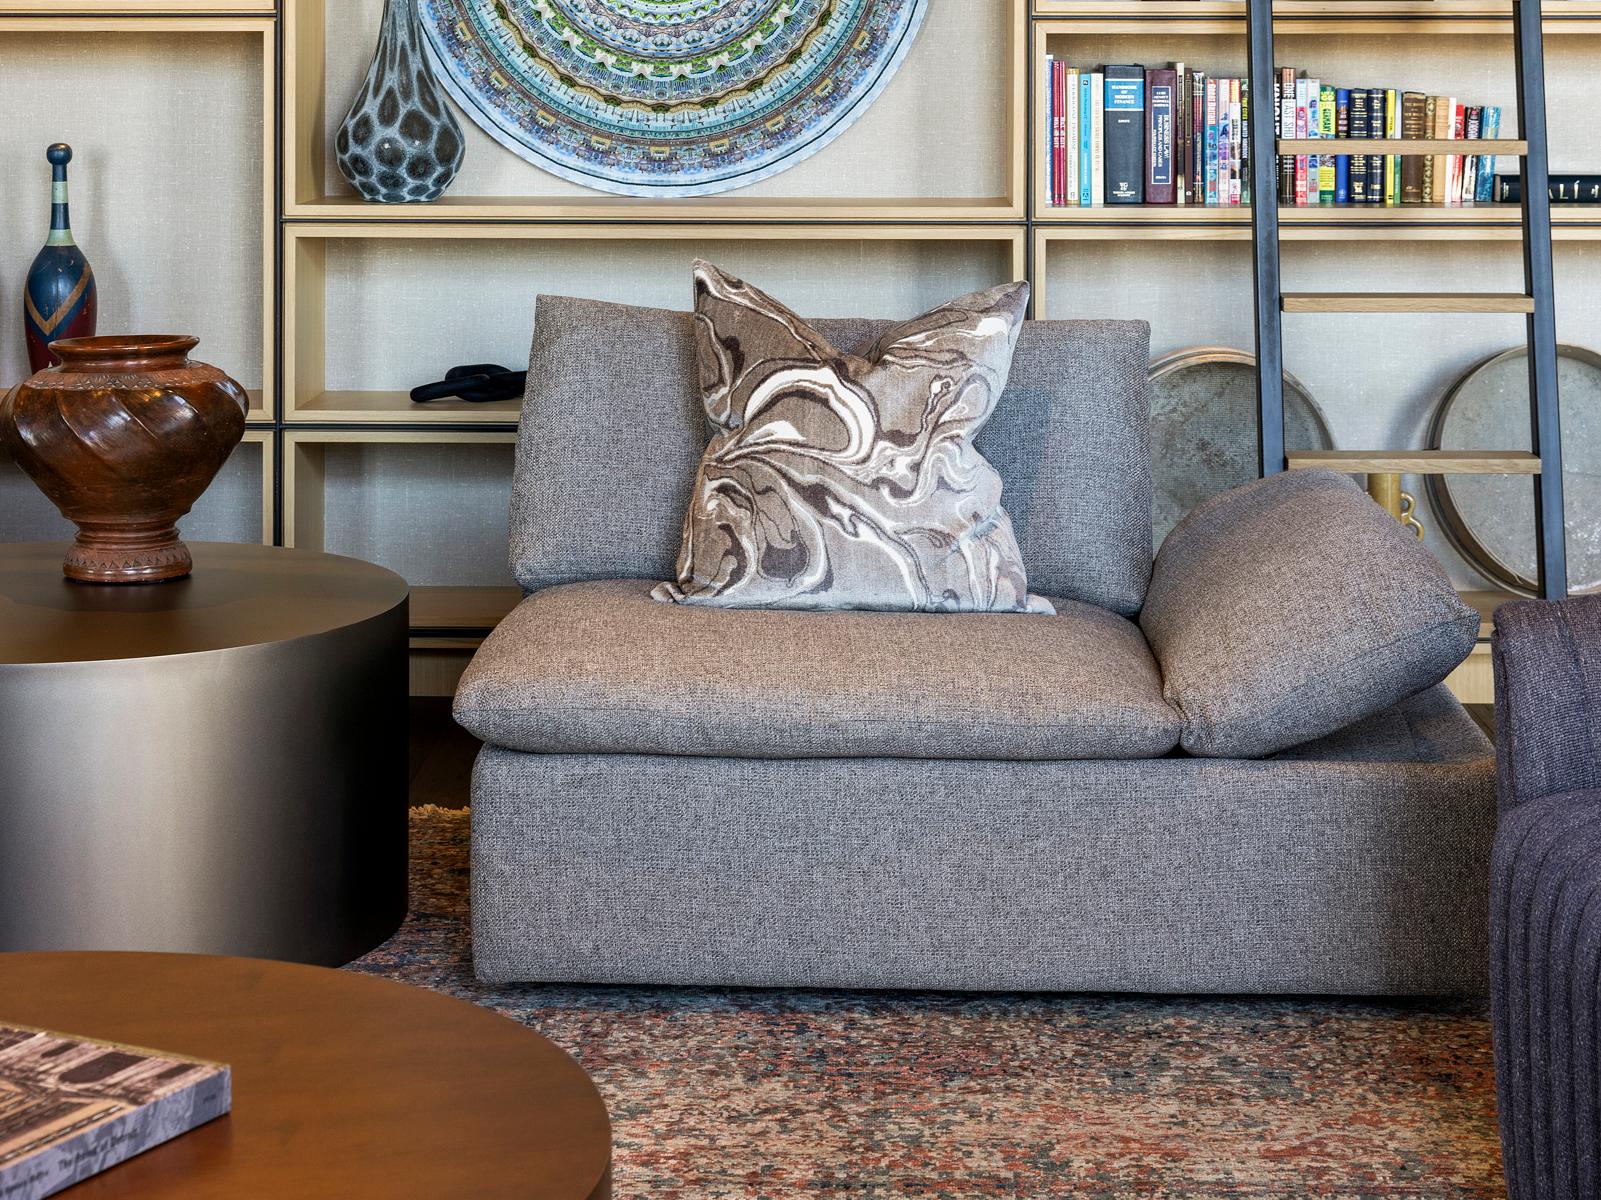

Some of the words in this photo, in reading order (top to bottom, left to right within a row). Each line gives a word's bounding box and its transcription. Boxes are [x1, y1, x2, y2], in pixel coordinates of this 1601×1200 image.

[1207, 83, 1217, 102] GREAT
[1284, 82, 1295, 99] ONE
[1207, 102, 1217, 125] BRITAIN
[1284, 100, 1295, 118] LAST
[1323, 108, 1332, 133] GERMANY
[1284, 122, 1295, 139] SHO
